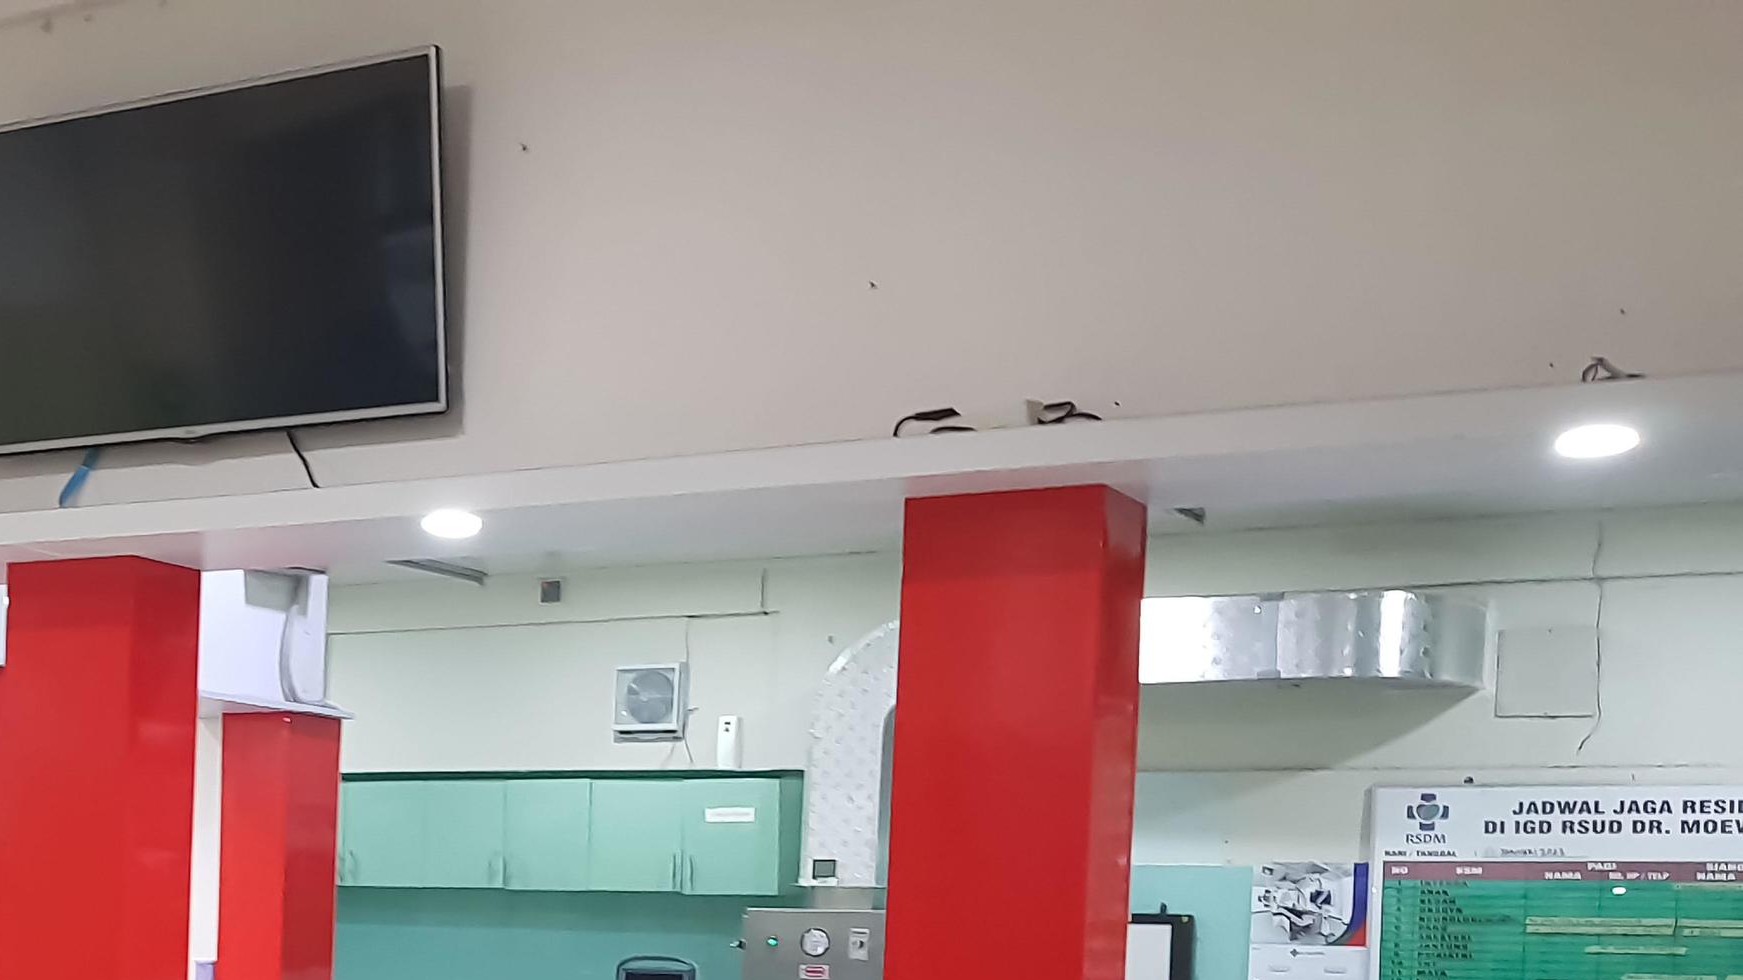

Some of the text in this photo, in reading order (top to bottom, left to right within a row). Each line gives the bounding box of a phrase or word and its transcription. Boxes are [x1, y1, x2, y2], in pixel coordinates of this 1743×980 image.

[1512, 800, 1605, 815] JADWAL
[1612, 800, 1673, 815] JAGA
[1484, 820, 1505, 834] DI
[1514, 820, 1552, 834] IGD
[1561, 820, 1623, 834] RSUD
[1631, 820, 1671, 834] DR.
[1405, 833, 1446, 844] RSDM
[1544, 871, 1582, 880] NAMA
[1696, 871, 1736, 880] NAMA
